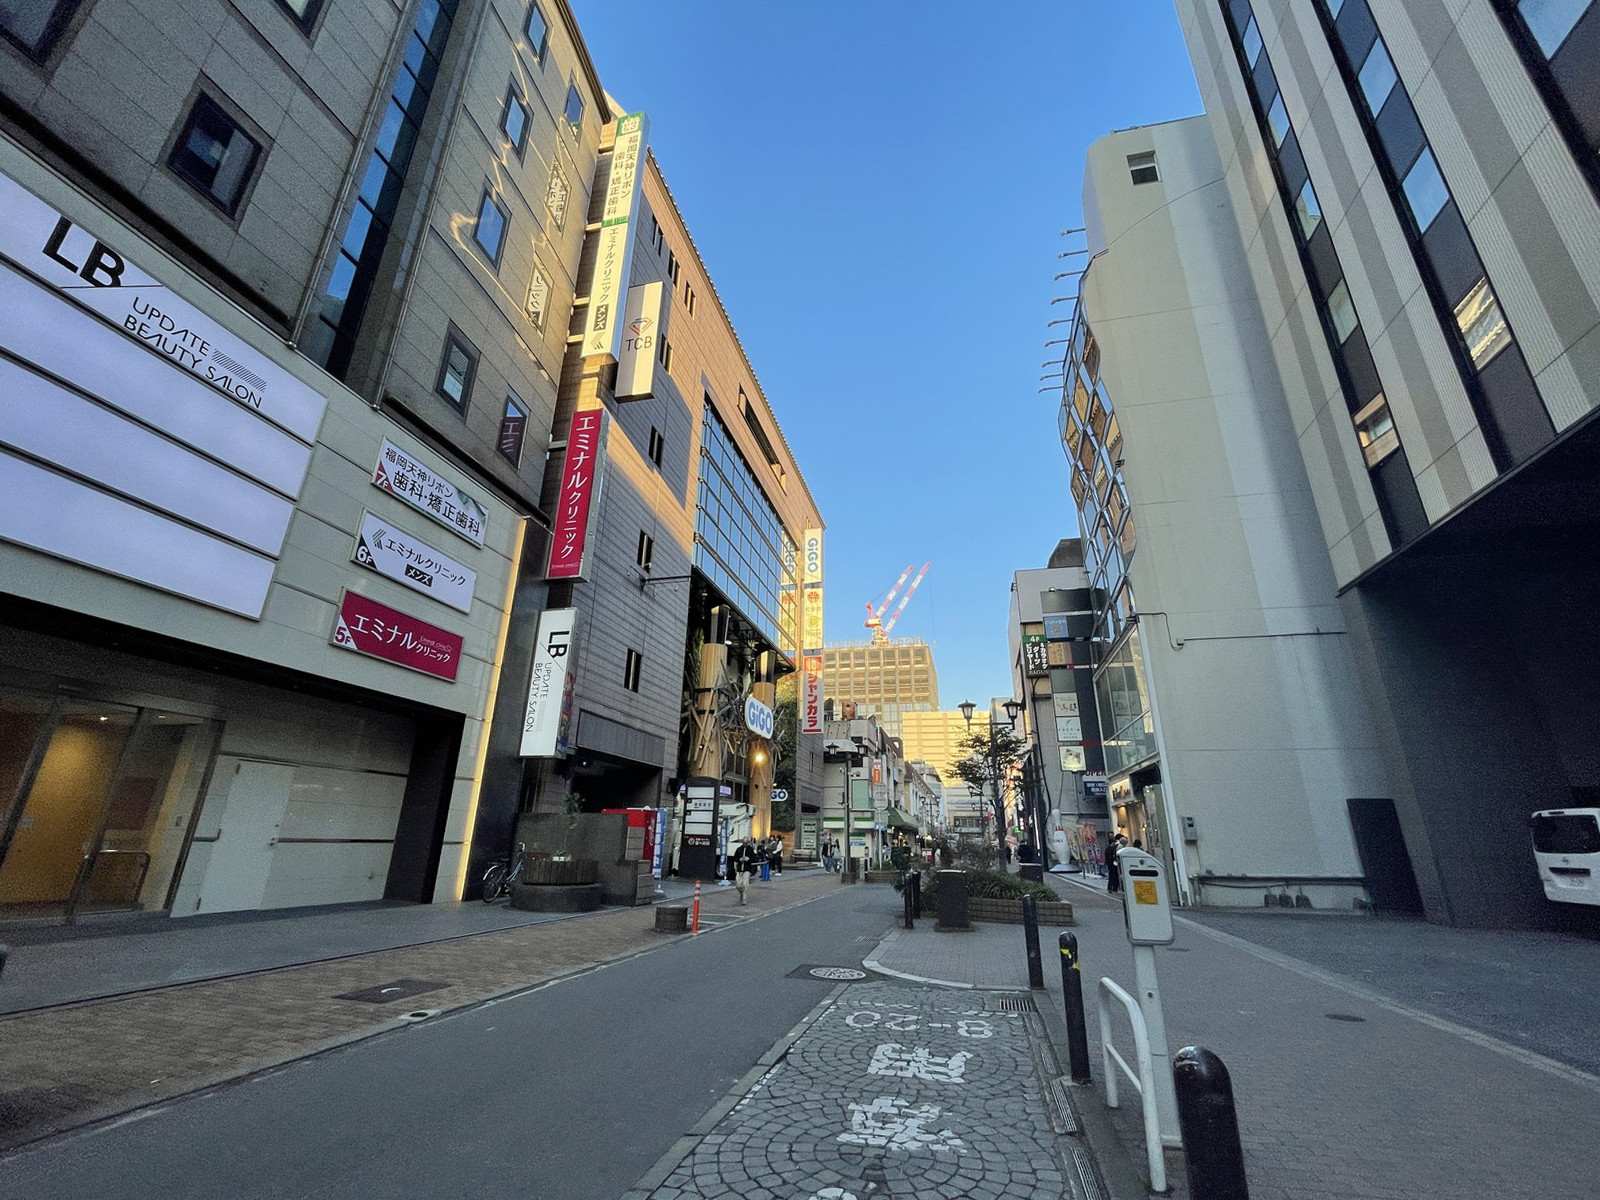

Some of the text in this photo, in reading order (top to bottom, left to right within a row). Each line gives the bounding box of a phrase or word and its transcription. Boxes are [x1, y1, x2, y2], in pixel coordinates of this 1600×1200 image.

[42, 215, 126, 288] LB
[599, 228, 618, 302] エミナルクリニック
[132, 297, 211, 356] UPDATE
[594, 305, 607, 330] メンズ
[123, 314, 262, 409] BEAUTY SALON
[626, 336, 652, 351] TCB
[377, 471, 389, 489] 7F
[385, 447, 454, 498] 福岡天神リボン
[561, 416, 595, 559] エミナルクリニック
[393, 470, 480, 537] 歯科・矯正歯科
[357, 545, 373, 565] 6F
[385, 538, 466, 586] エミナルクリニック
[407, 566, 431, 585] メンズ
[334, 626, 352, 644] 5F
[548, 630, 570, 659] LB
[525, 662, 543, 733] BEAUTY SALON
[540, 662, 552, 698] UPDATE
[749, 700, 772, 735] GiGO
